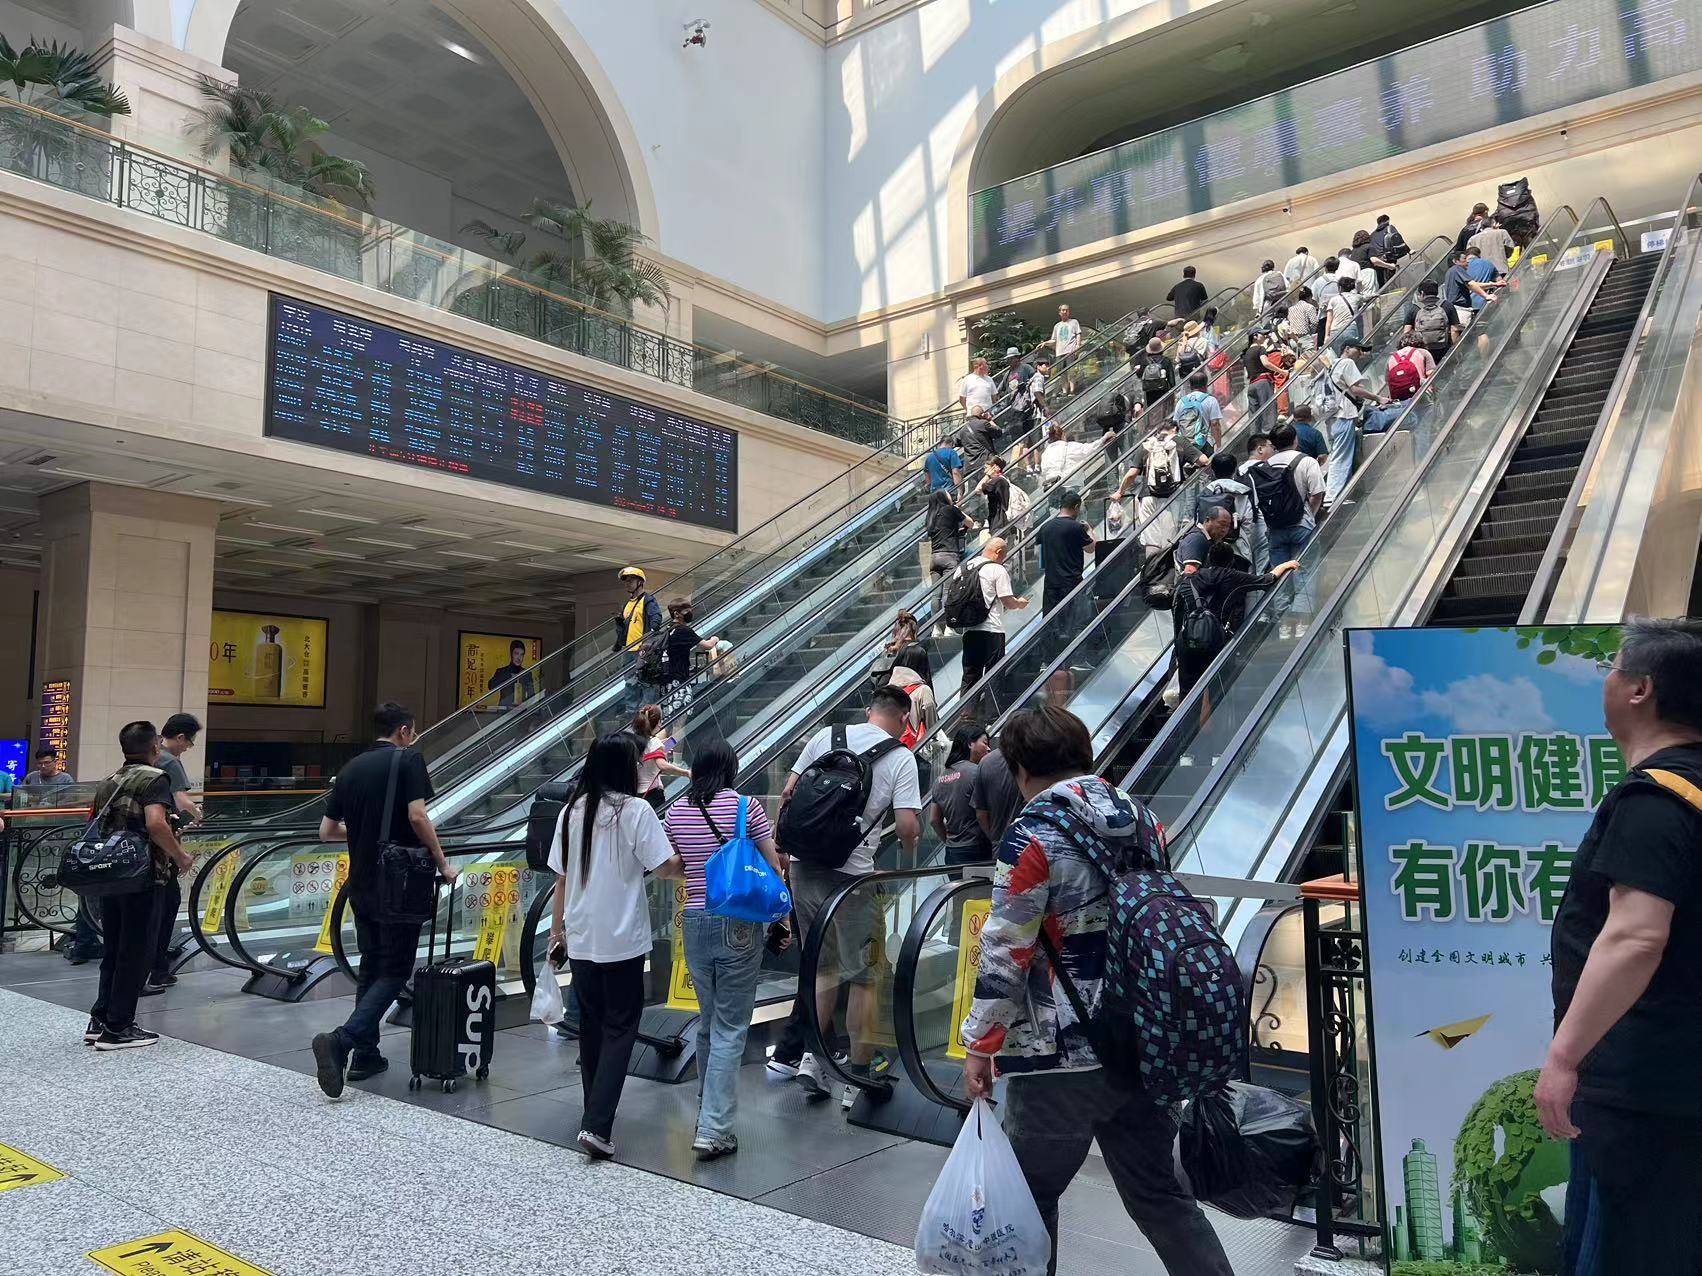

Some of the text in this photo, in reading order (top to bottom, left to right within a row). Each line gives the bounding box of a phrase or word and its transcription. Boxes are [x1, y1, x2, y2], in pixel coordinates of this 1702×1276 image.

[89, 862, 113, 871] SPORT
[1398, 949, 1527, 968] 创建全国文明城市
